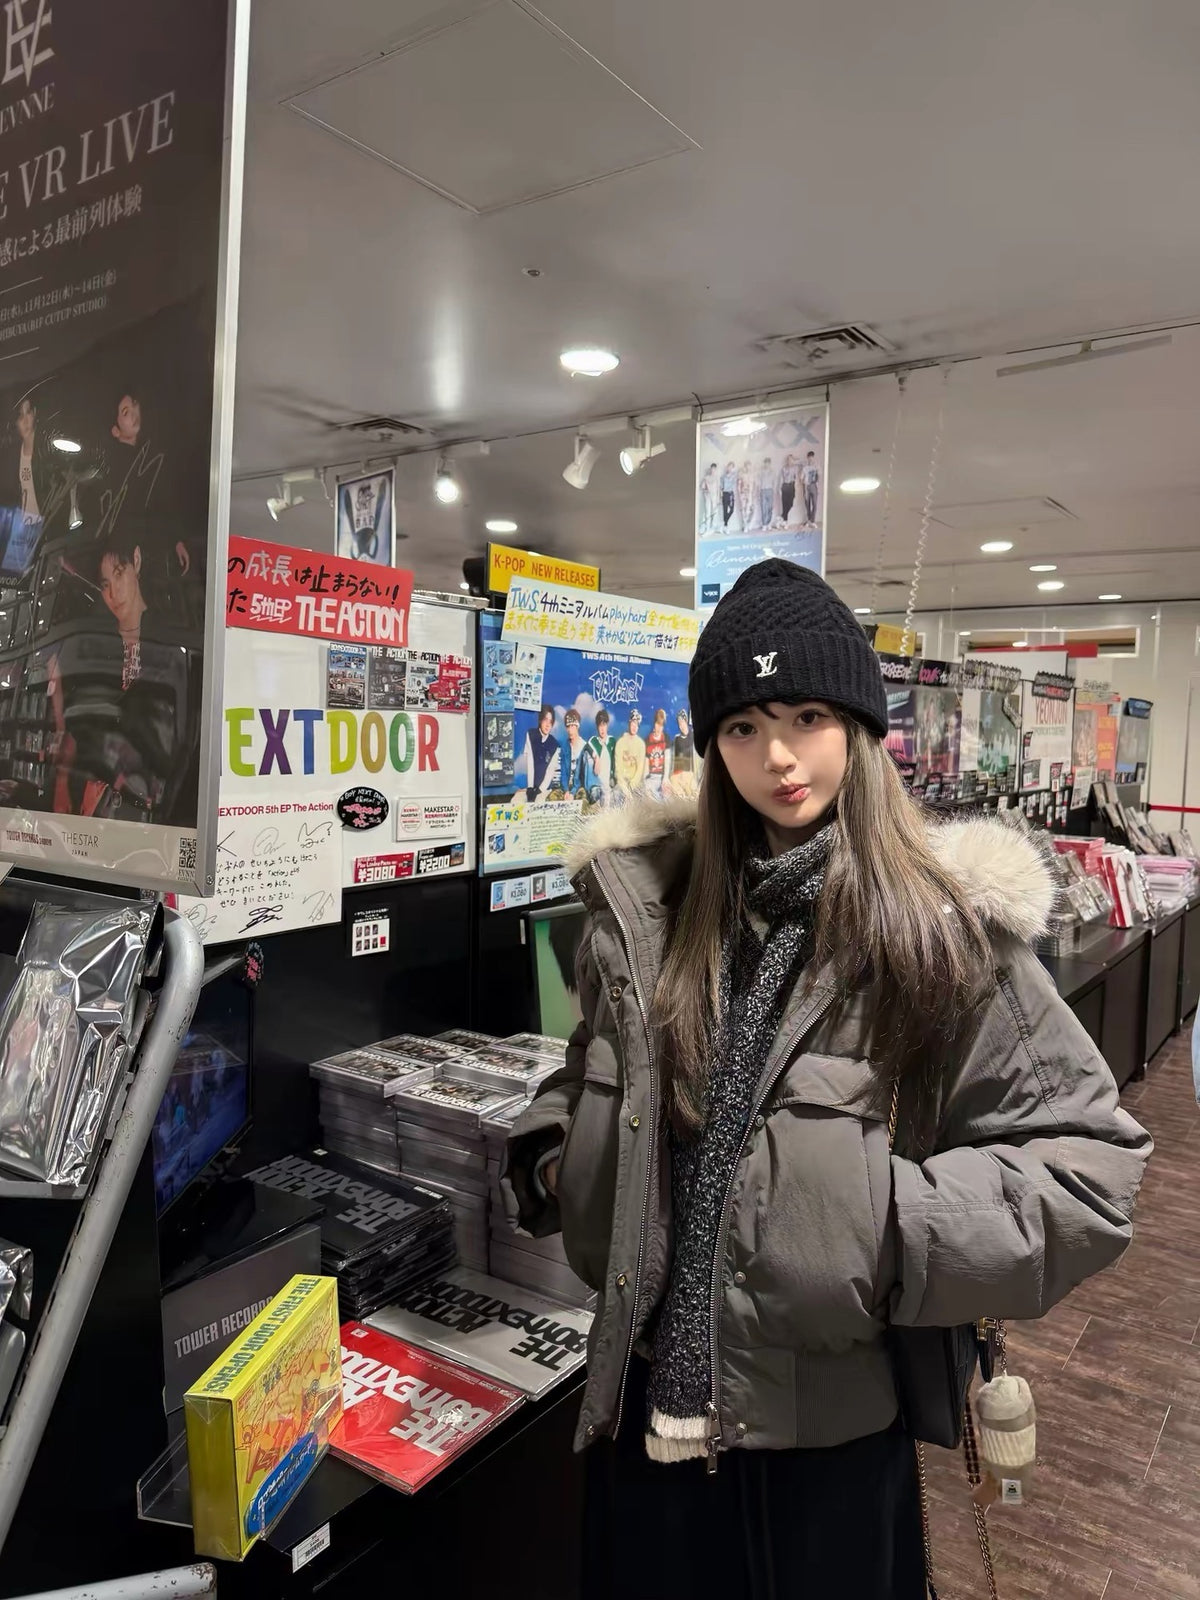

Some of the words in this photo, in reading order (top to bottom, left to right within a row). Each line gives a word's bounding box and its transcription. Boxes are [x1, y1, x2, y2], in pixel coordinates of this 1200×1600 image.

[19, 145, 67, 208] VR
[77, 90, 175, 184] LIVE
[493, 554, 526, 573] K-POP
[531, 562, 553, 578] NEW
[554, 567, 595, 587] RELEASES
[219, 707, 441, 777] EXTDOOR
[218, 805, 265, 817] EXTDOOR
[265, 805, 279, 814] 5th
[280, 804, 291, 813] EP
[292, 804, 306, 812] The
[308, 802, 334, 812] Action
[495, 809, 520, 821] TWS
[358, 865, 397, 883] ¥3080
[419, 854, 451, 873] ¥2200
[335, 1204, 391, 1234] THE
[291, 1278, 322, 1295] THE
[267, 1295, 305, 1323] FIRST
[174, 1321, 219, 1358] TOWER
[240, 1323, 281, 1351] DOOR
[509, 1335, 570, 1371] THE
[389, 1410, 457, 1457] THE
